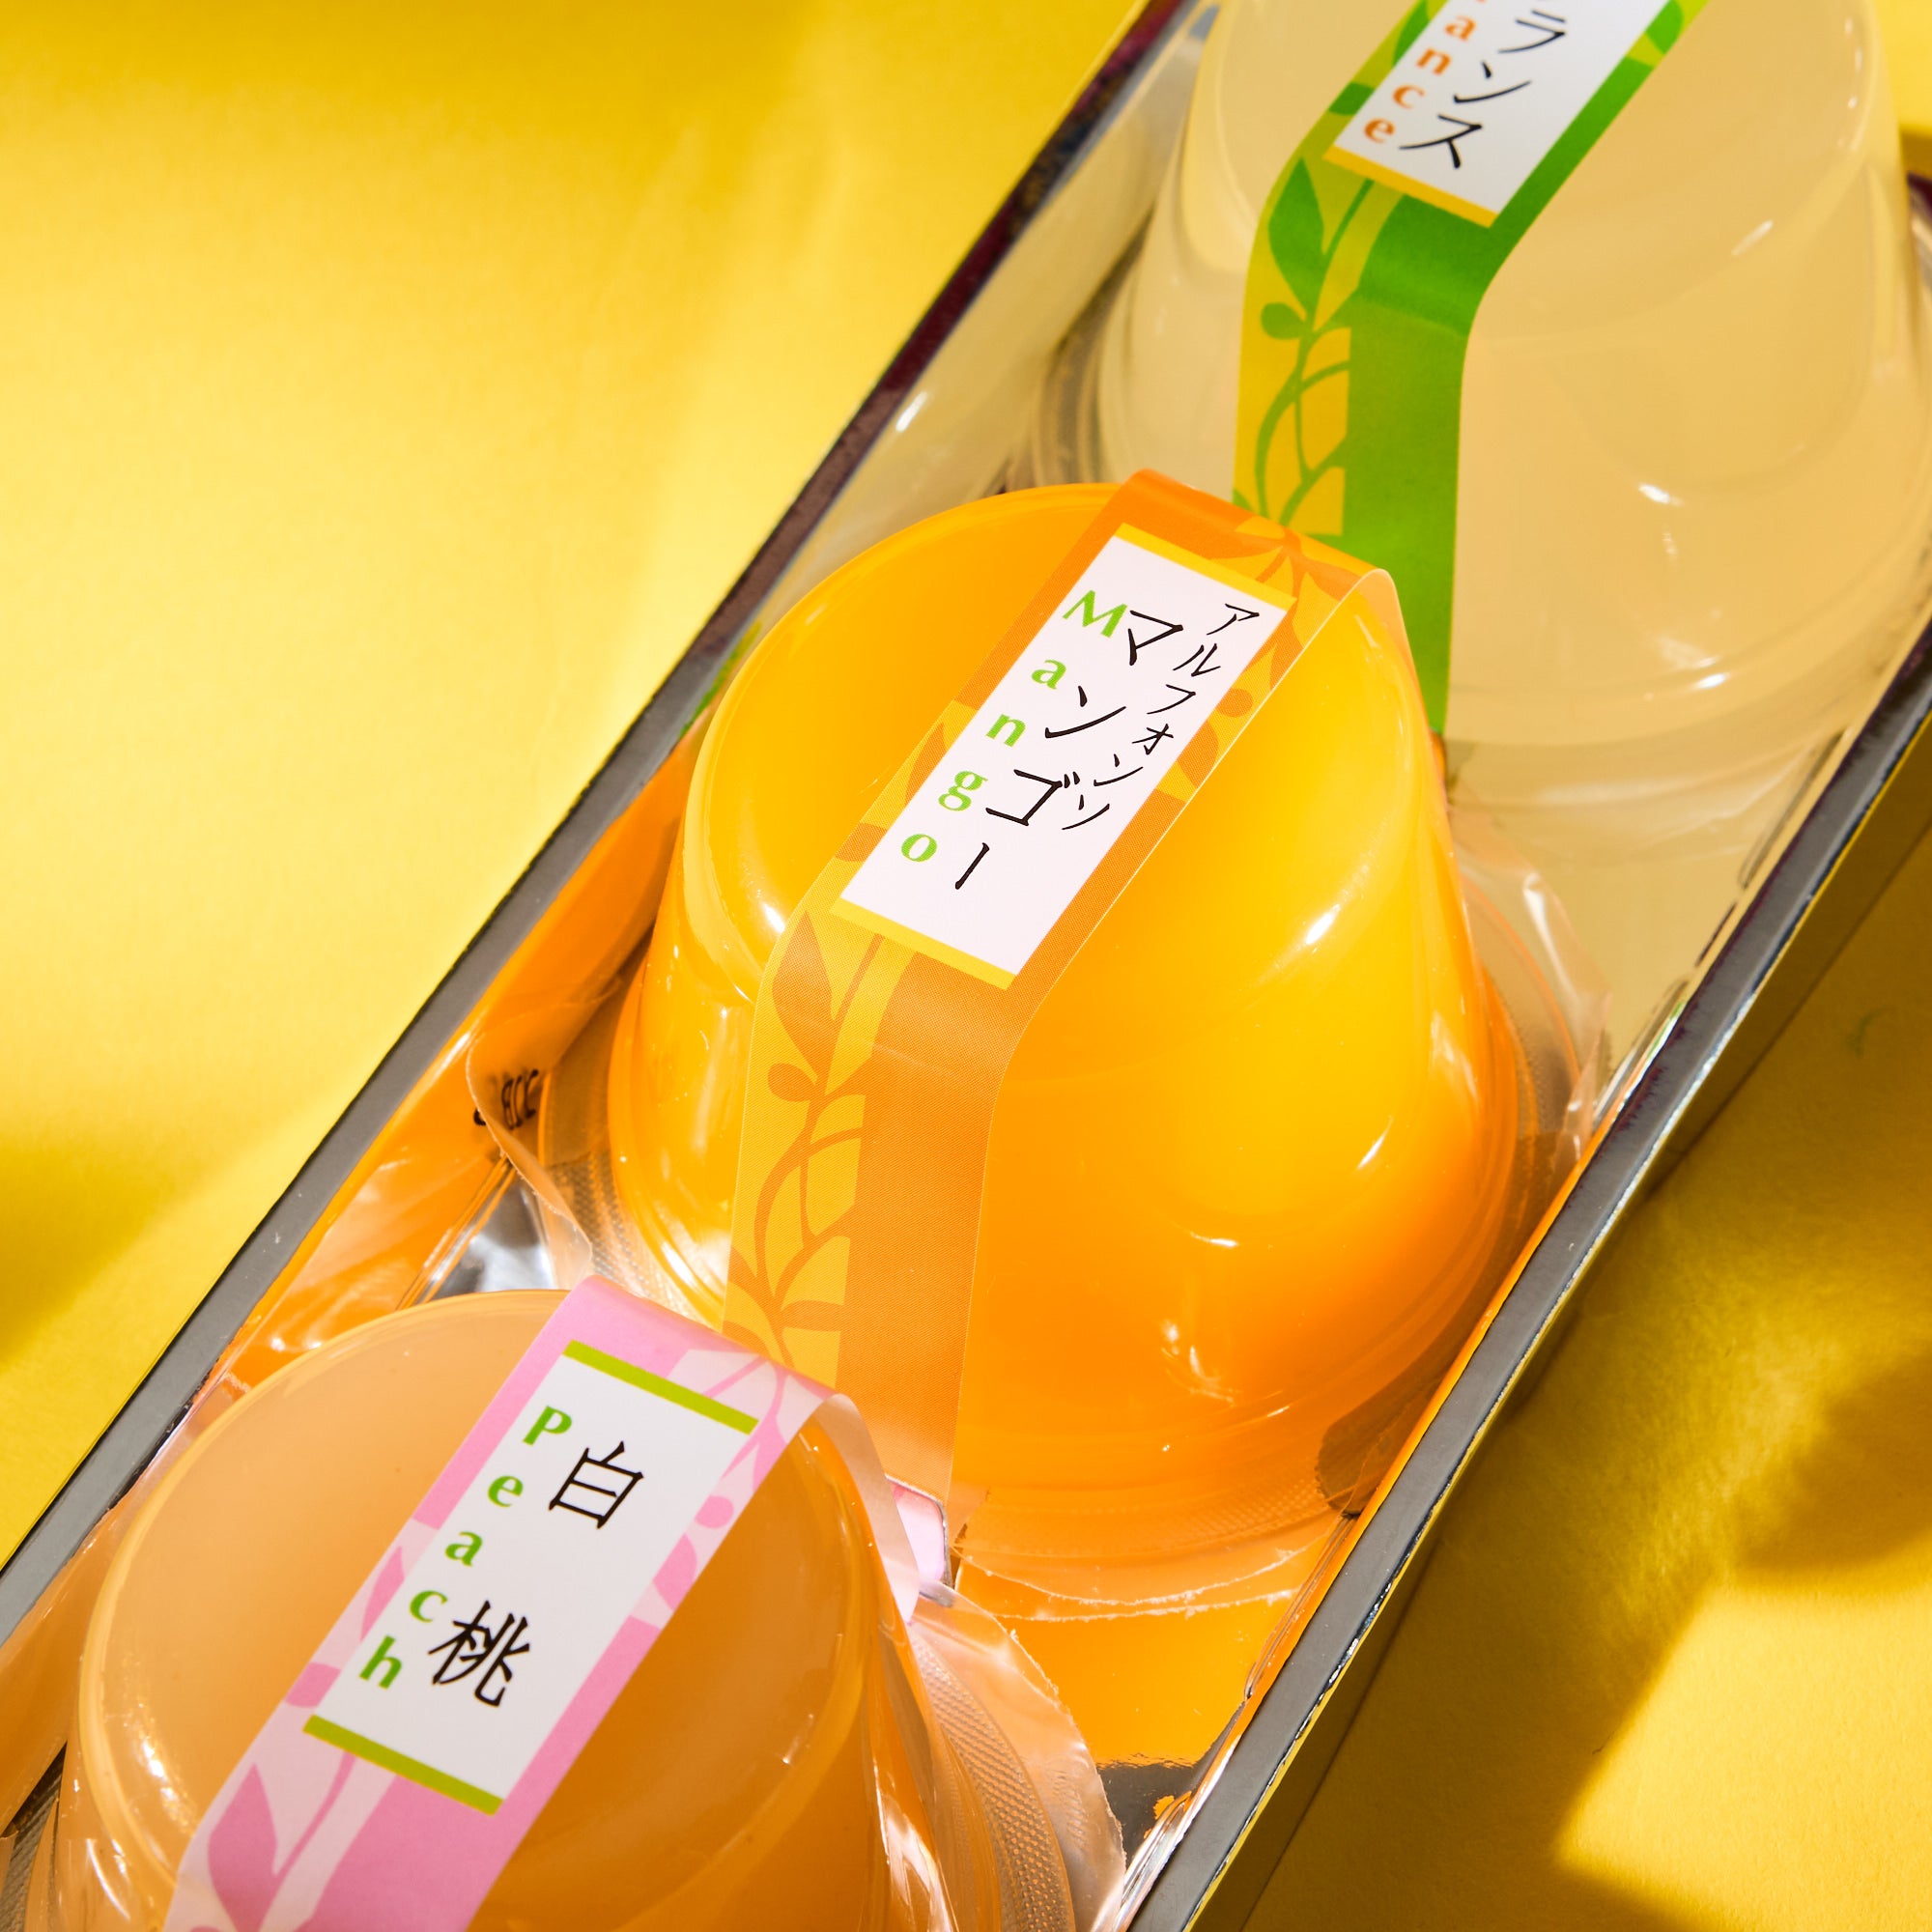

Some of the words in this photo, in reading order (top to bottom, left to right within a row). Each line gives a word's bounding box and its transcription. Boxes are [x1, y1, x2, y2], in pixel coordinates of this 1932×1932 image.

[1362, 0, 1486, 144] ance
[1401, 10, 1566, 169] ランス
[900, 589, 1128, 863] Mango
[954, 610, 1184, 891] マンゴー
[1062, 603, 1260, 831] アルフォンソ
[357, 1406, 573, 1690] Peach
[428, 1440, 644, 1707] 白桃
